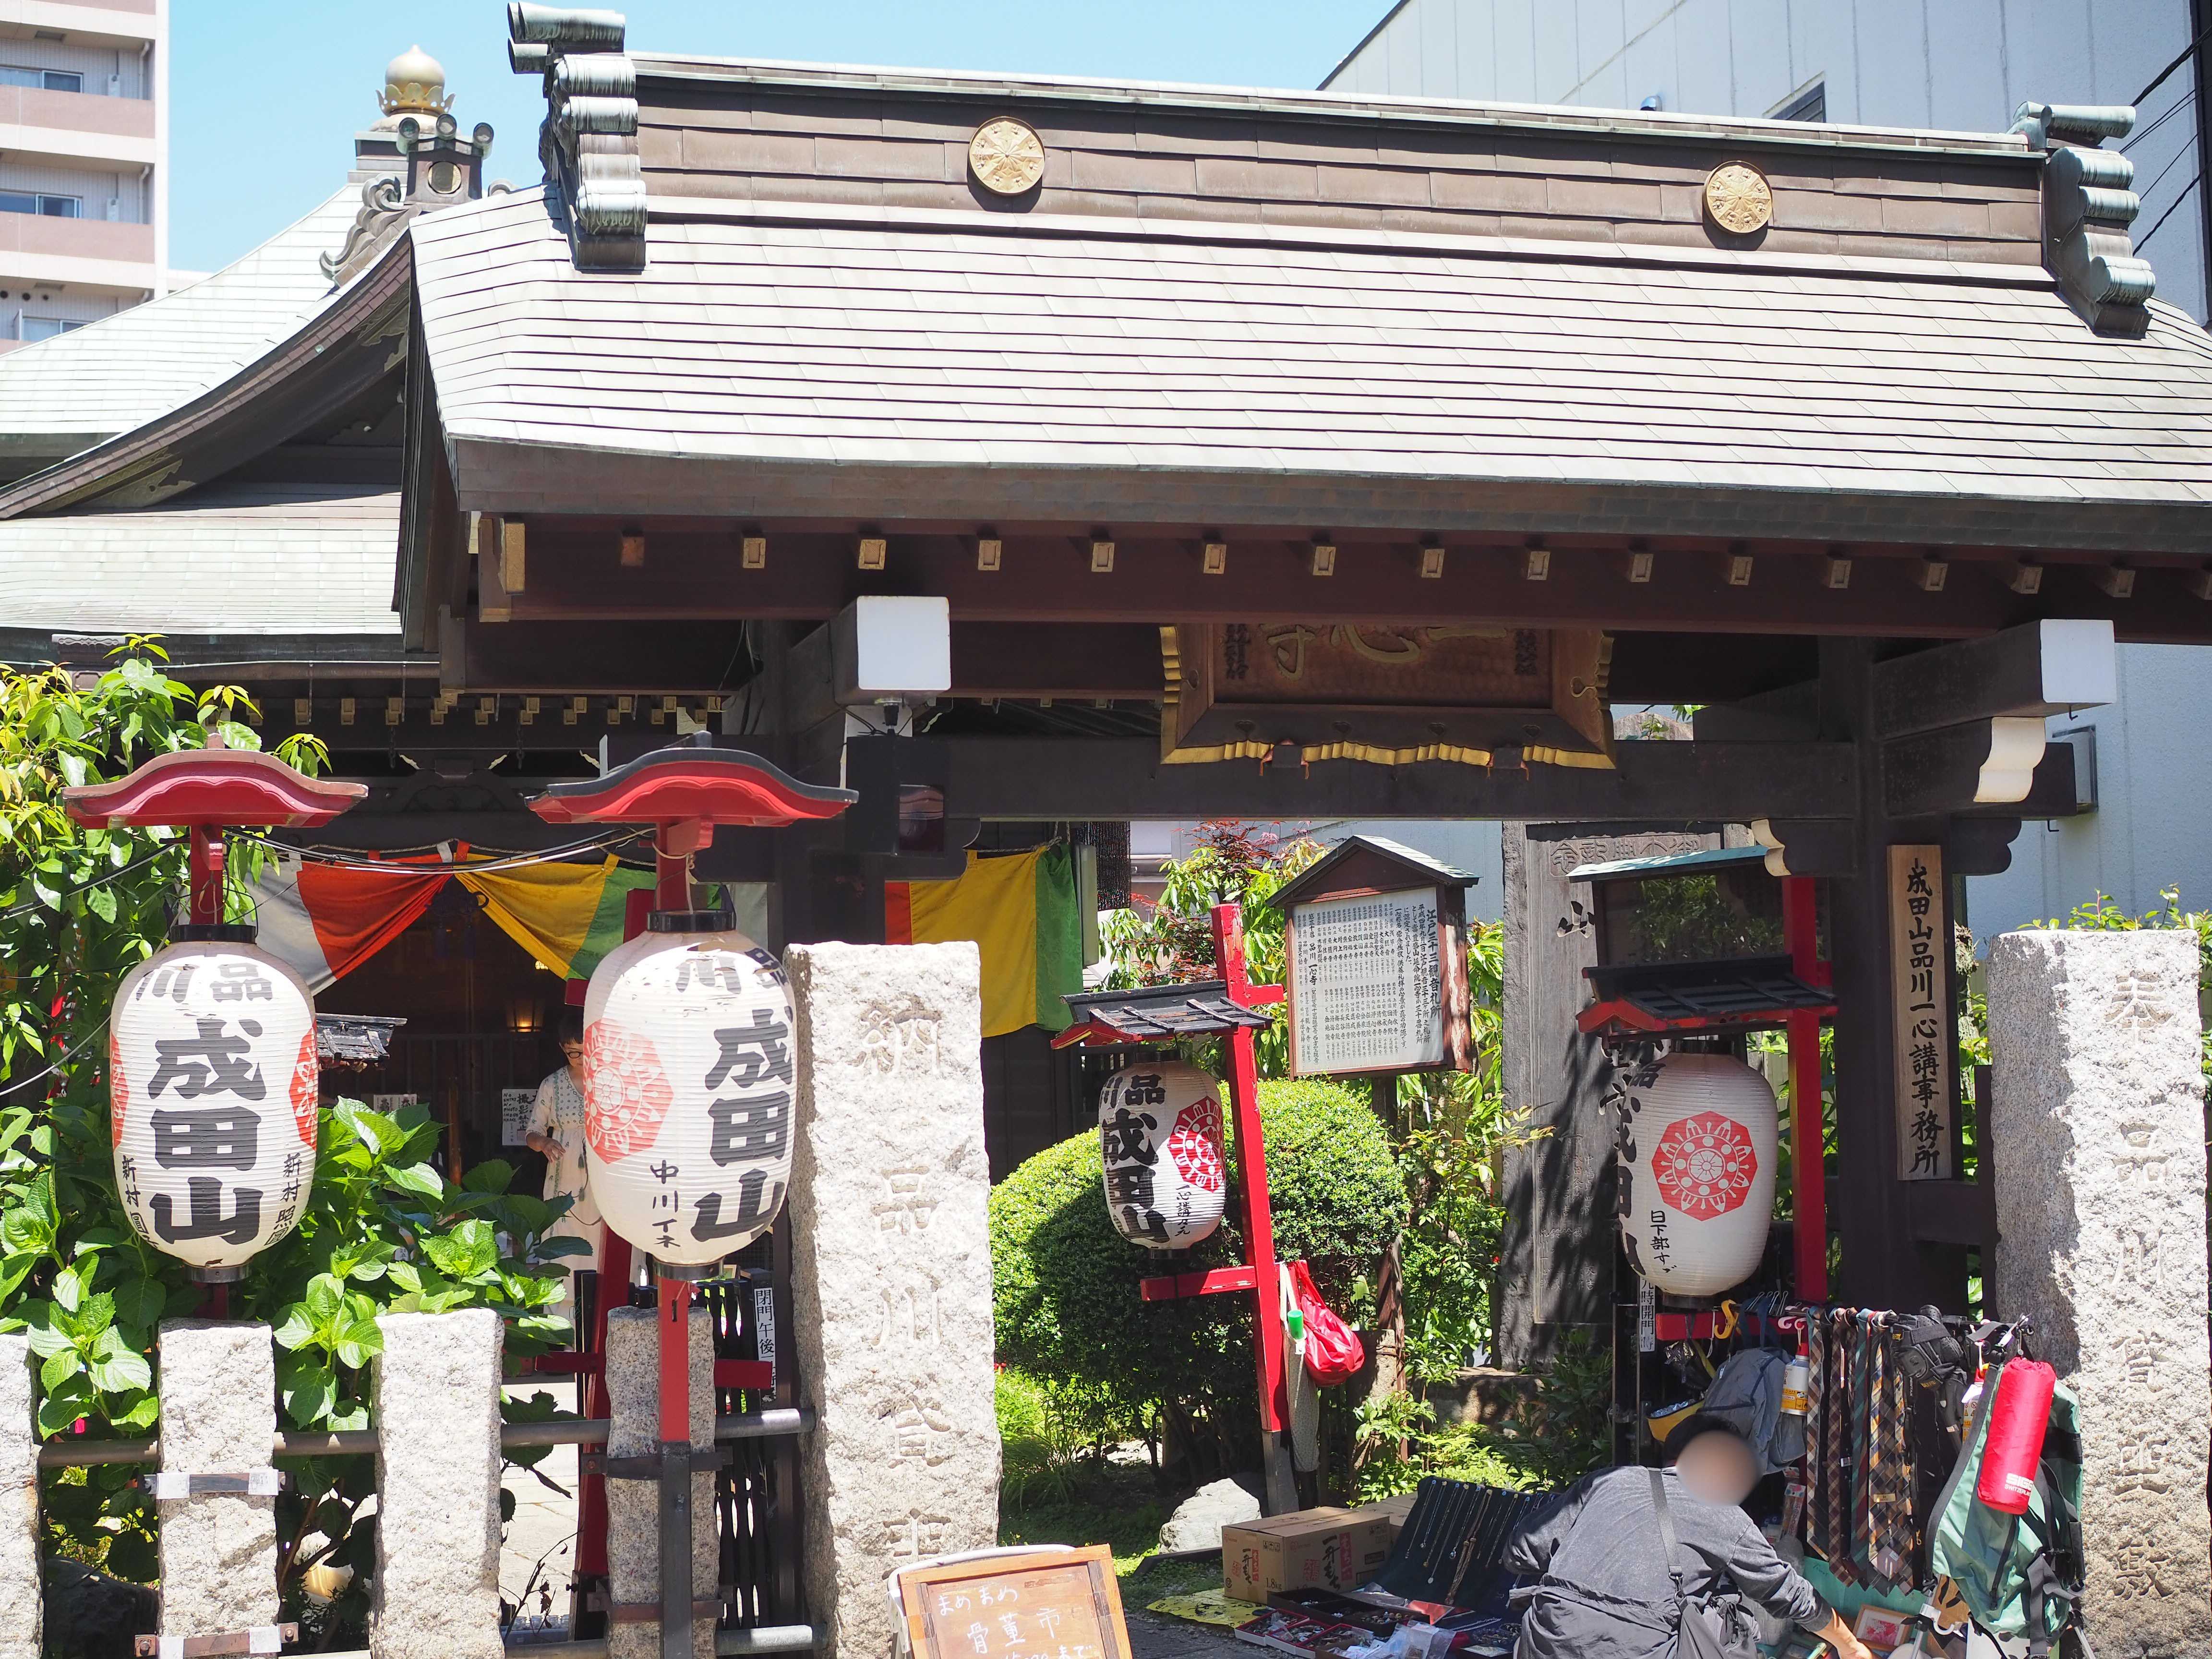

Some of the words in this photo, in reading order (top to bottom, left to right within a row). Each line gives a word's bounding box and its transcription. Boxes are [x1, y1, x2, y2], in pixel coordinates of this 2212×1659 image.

[135, 962, 273, 1004] 品川
[1308, 963, 1318, 986] 一心寺
[1309, 942, 1317, 961] 品川
[1425, 908, 1442, 1020] 江戸三十三観音札所
[1907, 864, 1945, 1176] 成田山品川一心講事務所
[148, 1018, 266, 1246] 成田山
[690, 1005, 794, 1243] 成田山
[1101, 1108, 1170, 1244] 成田山
[1265, 1577, 1283, 1591] 1.8kg
[966, 1608, 1060, 1654] 骨董市
